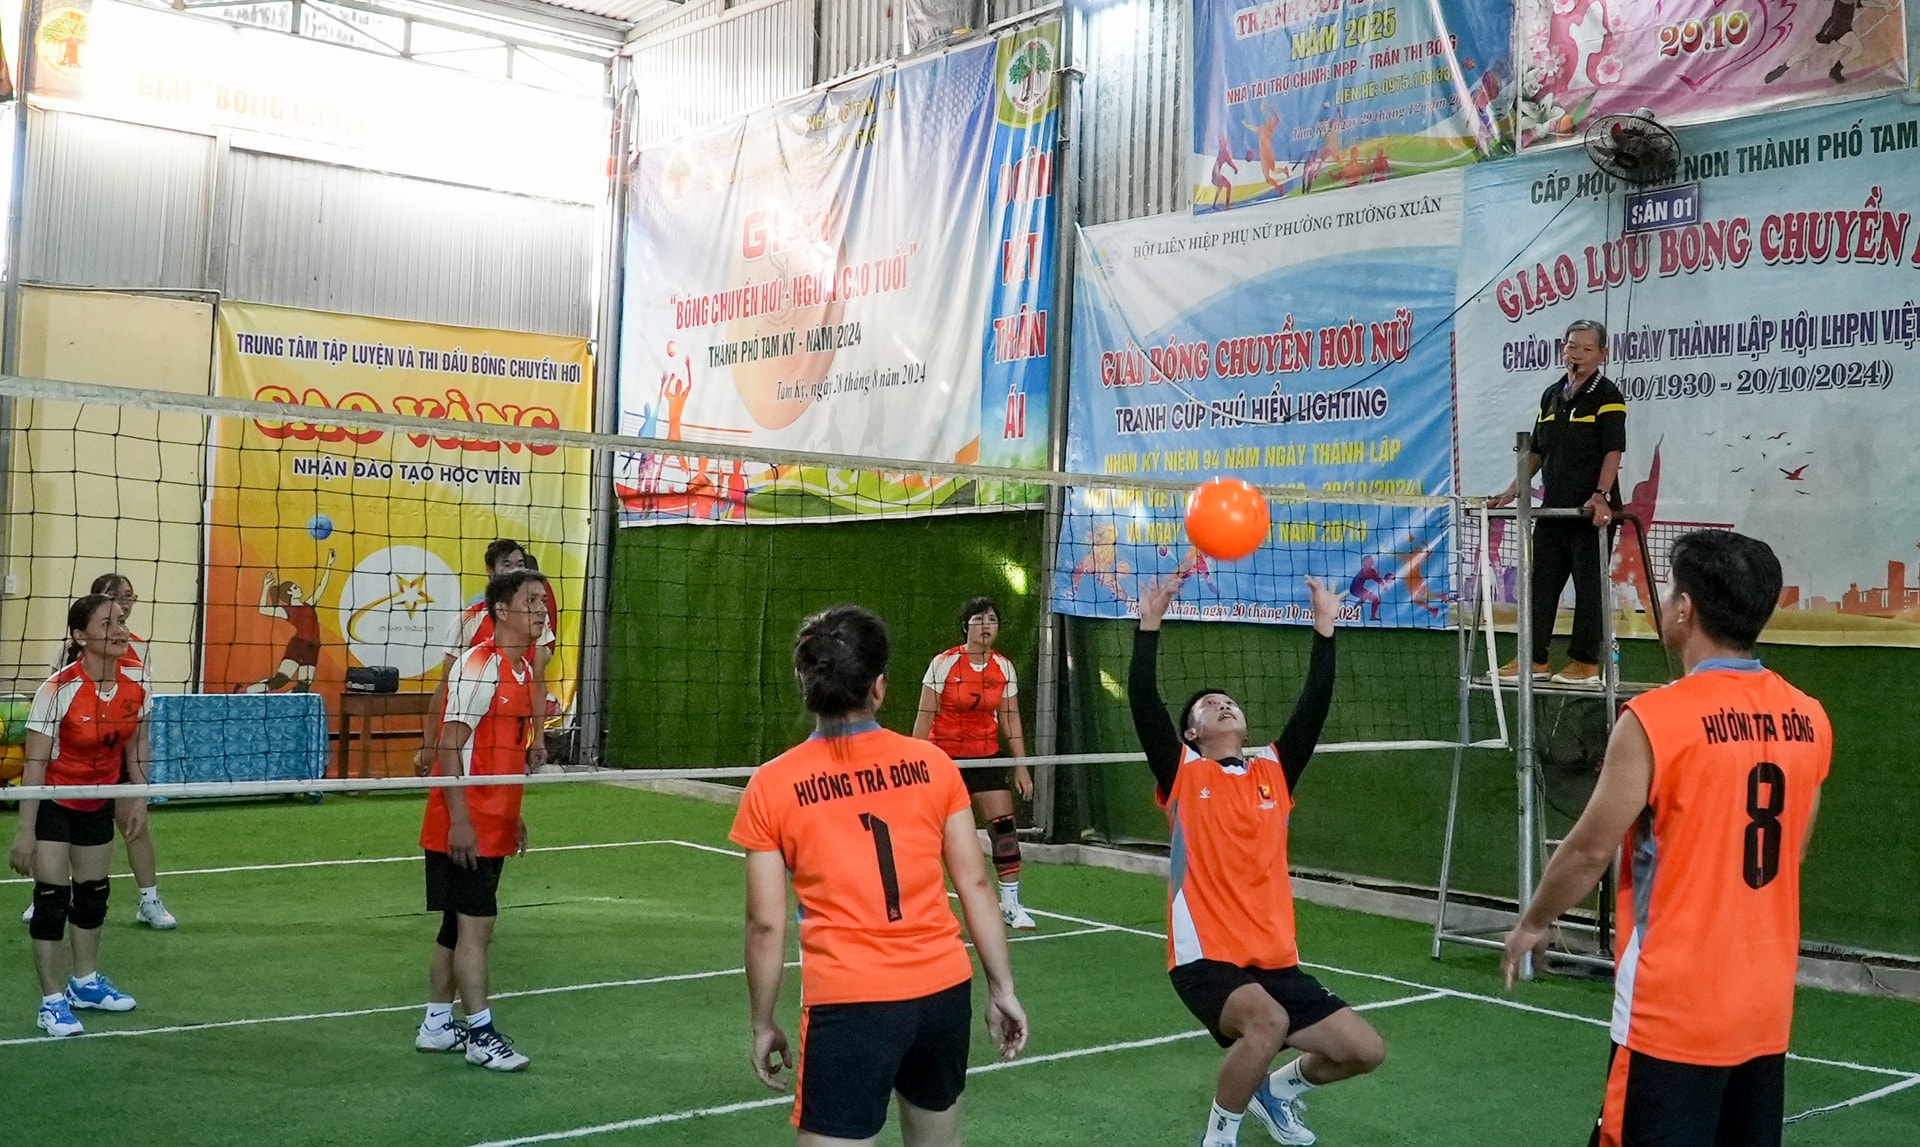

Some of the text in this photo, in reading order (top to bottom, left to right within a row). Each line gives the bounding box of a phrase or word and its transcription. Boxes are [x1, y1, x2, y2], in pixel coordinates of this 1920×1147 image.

[1291, 7, 1397, 61] NĂM 2025
[1660, 11, 1750, 57] 20.10
[1226, 82, 1248, 105] NHÀ
[1250, 78, 1267, 99] TÀI
[1270, 73, 1291, 95] TRỢ
[1333, 60, 1358, 79] NPP
[1403, 43, 1423, 62] THỊ
[1360, 111, 1374, 126] 29
[1408, 102, 1421, 115] 12
[1531, 169, 1571, 205] CẤP
[1577, 172, 1617, 202] HỌC
[1684, 151, 1730, 183] NON
[1738, 131, 1809, 174] THÀNH
[1817, 118, 1864, 162] PHỐ
[1870, 120, 1919, 154] TAM
[1134, 195, 1442, 261] HỘI LIÊN HIỆP PHỤ NỮ PHƯỜNG TRƯỜNG XUÂN
[1631, 196, 1693, 225] SÂN 01
[1494, 251, 1578, 323] GIAO
[237, 333, 581, 383] TRUNG TÂM TẬP LUYỆN VÀ THI ĐẤU BÓNG CHUYỀN HƠI
[708, 342, 738, 369] THÀNH
[741, 328, 760, 363] PHỐ
[761, 334, 780, 360] TAM
[782, 326, 796, 356] KỲ
[805, 322, 833, 353] NĂM
[837, 321, 862, 349] 2024
[994, 302, 1048, 364] THÂN
[1100, 336, 1145, 388] GIẢI
[1148, 334, 1210, 383] BÓNG
[1318, 317, 1365, 368] HƠI
[1370, 307, 1415, 363] NỮ
[1502, 333, 1551, 371] CHÀO
[1613, 325, 1666, 364] NGÀY
[1668, 318, 1734, 360] THÀNH
[1737, 314, 1777, 361] LẬP
[1780, 310, 1818, 358] HỘI
[1821, 310, 1878, 349] LHPN
[776, 380, 793, 401] Tam
[809, 376, 833, 402] ngày
[843, 369, 871, 396] tháng
[872, 368, 879, 389] 8
[879, 367, 900, 387] năm
[901, 361, 928, 385] 2024
[1736, 358, 1894, 396] 20/10/2024)
[254, 384, 561, 456] SAO VÀNG
[1003, 383, 1027, 440] ÁI
[1115, 405, 1167, 434] TRANH
[1210, 391, 1247, 428] PHÚ
[1251, 380, 1293, 425] HIỂN
[1299, 386, 1388, 423] LIGHTING
[294, 456, 521, 488] NHẬN ĐÀO TẠO HỌC VIÊN
[1164, 446, 1199, 476] NIỆM
[1203, 449, 1221, 470] 94
[1225, 442, 1260, 469] NĂM
[1264, 439, 1308, 468] NGÀY
[1311, 437, 1366, 466] THÀNH
[1369, 434, 1403, 467] LẬP
[1232, 603, 1245, 618] 20
[1248, 602, 1282, 621] tháng
[1285, 604, 1300, 620] 10
[970, 692, 982, 711] 7
[1781, 707, 1815, 743] ĐÔNG
[793, 758, 931, 808] HƯƠNG TRÀ ĐÔNG
[1742, 761, 1786, 890] 8
[858, 812, 903, 923] 1
